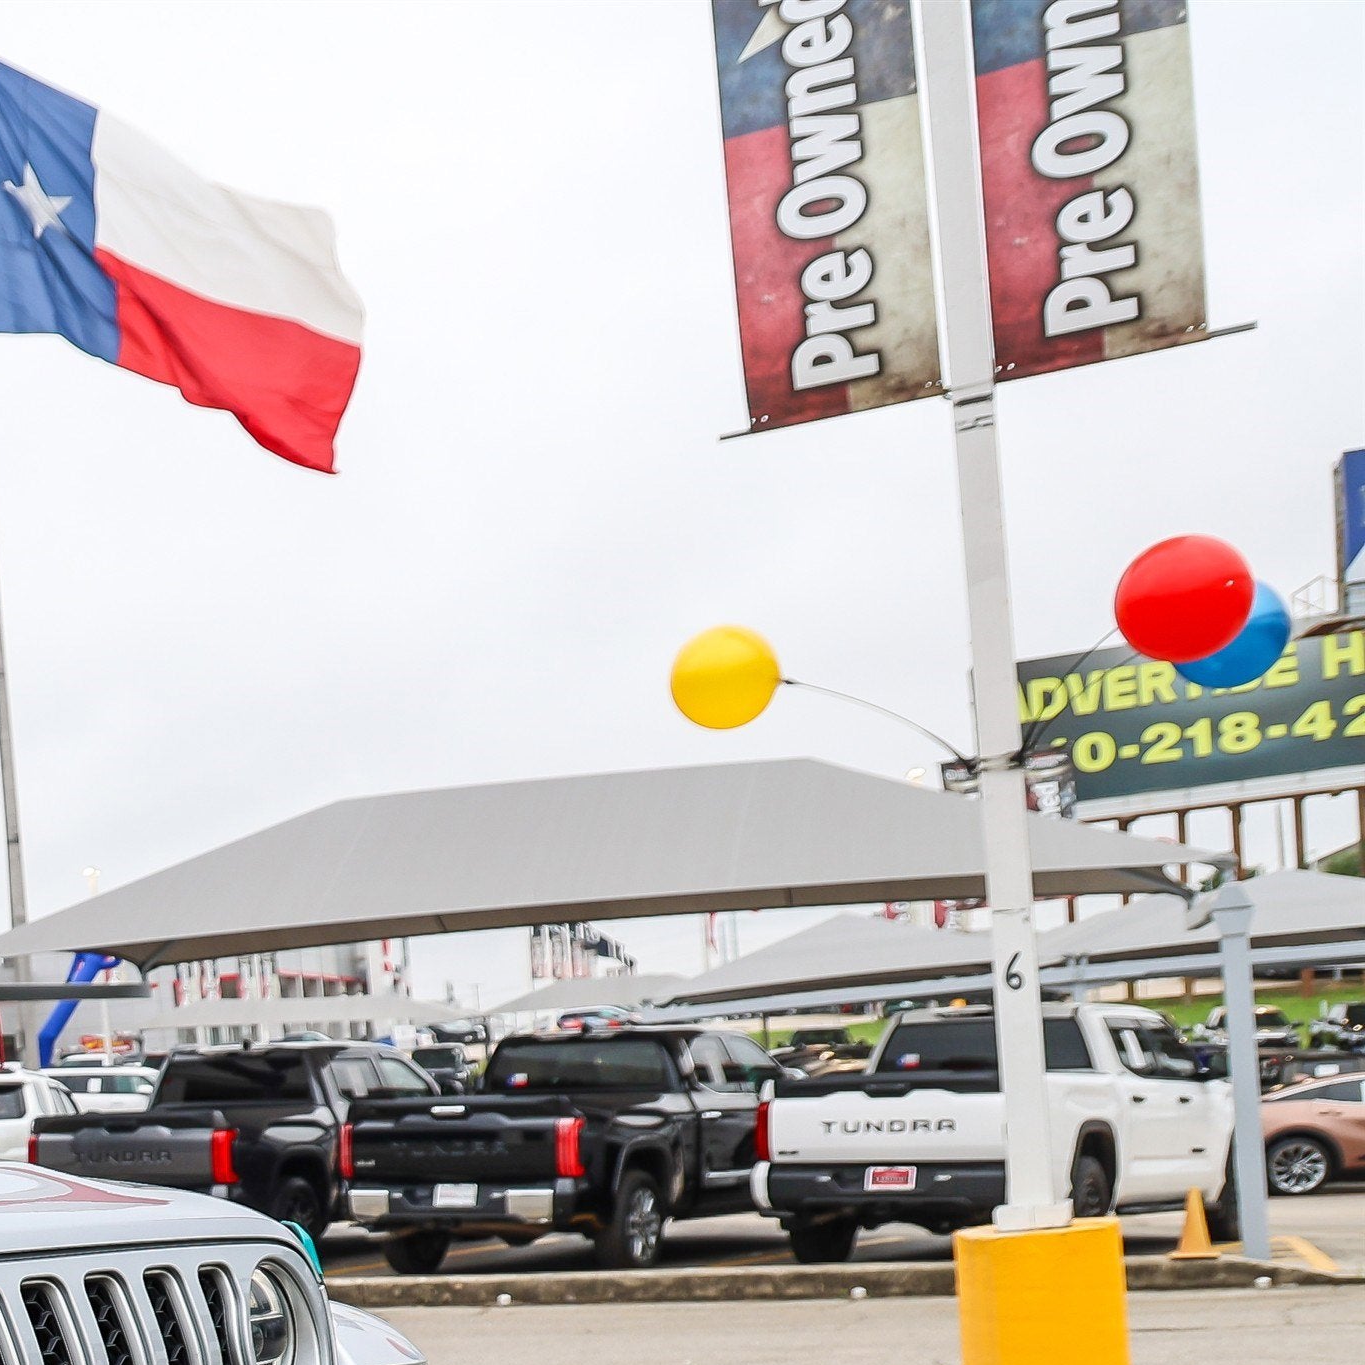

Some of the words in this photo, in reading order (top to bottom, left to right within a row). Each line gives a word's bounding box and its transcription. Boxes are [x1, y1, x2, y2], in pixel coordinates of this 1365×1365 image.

[1043, 186, 1139, 338] Pre
[790, 246, 880, 391] Pre
[1005, 950, 1025, 991] 6
[821, 1118, 957, 1134] TUNDRA
[72, 1150, 173, 1165] TUNDRA
